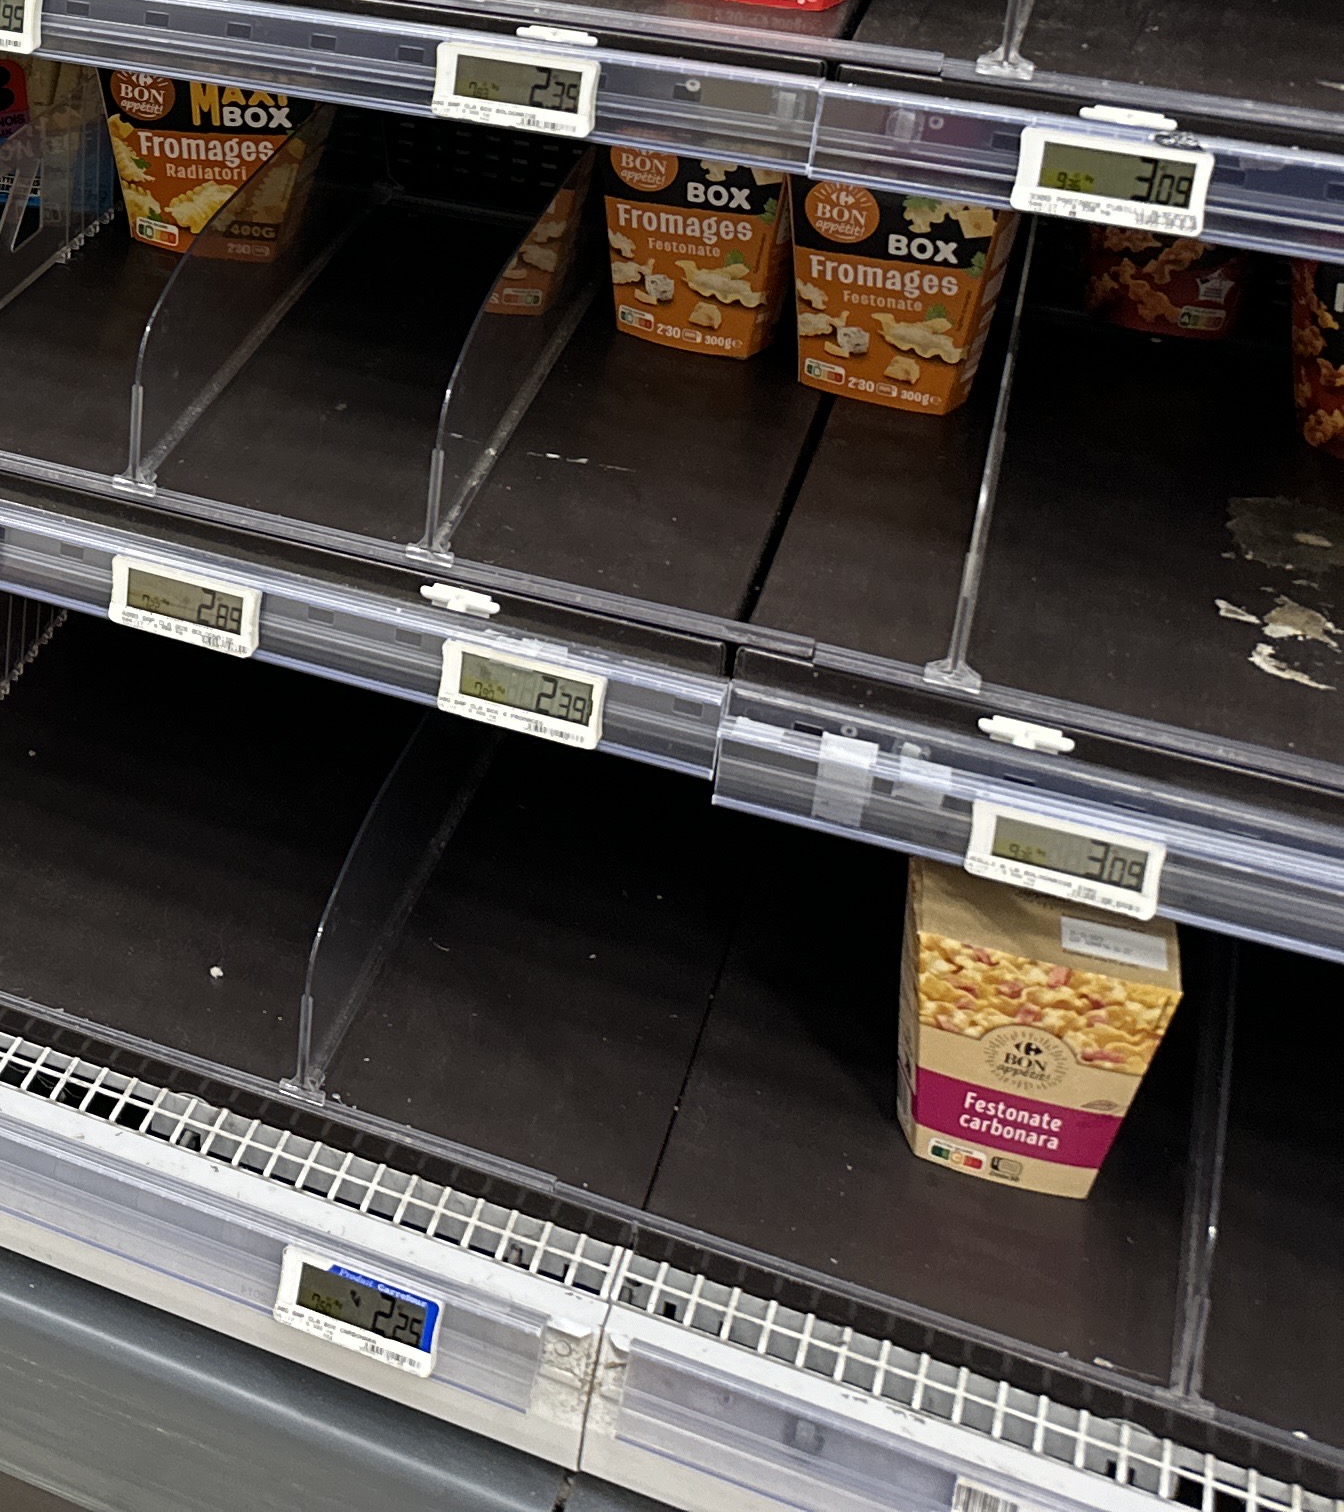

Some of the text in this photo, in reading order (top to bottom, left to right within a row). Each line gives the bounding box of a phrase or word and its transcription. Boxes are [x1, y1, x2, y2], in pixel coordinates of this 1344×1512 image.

[119, 82, 165, 104] BON
[222, 106, 293, 129] BOX
[136, 131, 275, 168] Fromages
[165, 162, 248, 181] Radiatori
[619, 152, 668, 176] BON
[686, 181, 751, 211] BOX
[615, 203, 754, 245] Fromages
[815, 201, 867, 226] BON
[647, 236, 721, 259] Festonate
[887, 233, 958, 265] BOX
[808, 253, 960, 297] Fromages
[842, 289, 923, 312] Festonate
[1003, 1051, 1048, 1072] BON
[963, 1090, 1063, 1133] Festonate
[958, 1112, 1060, 1150] carbonara
